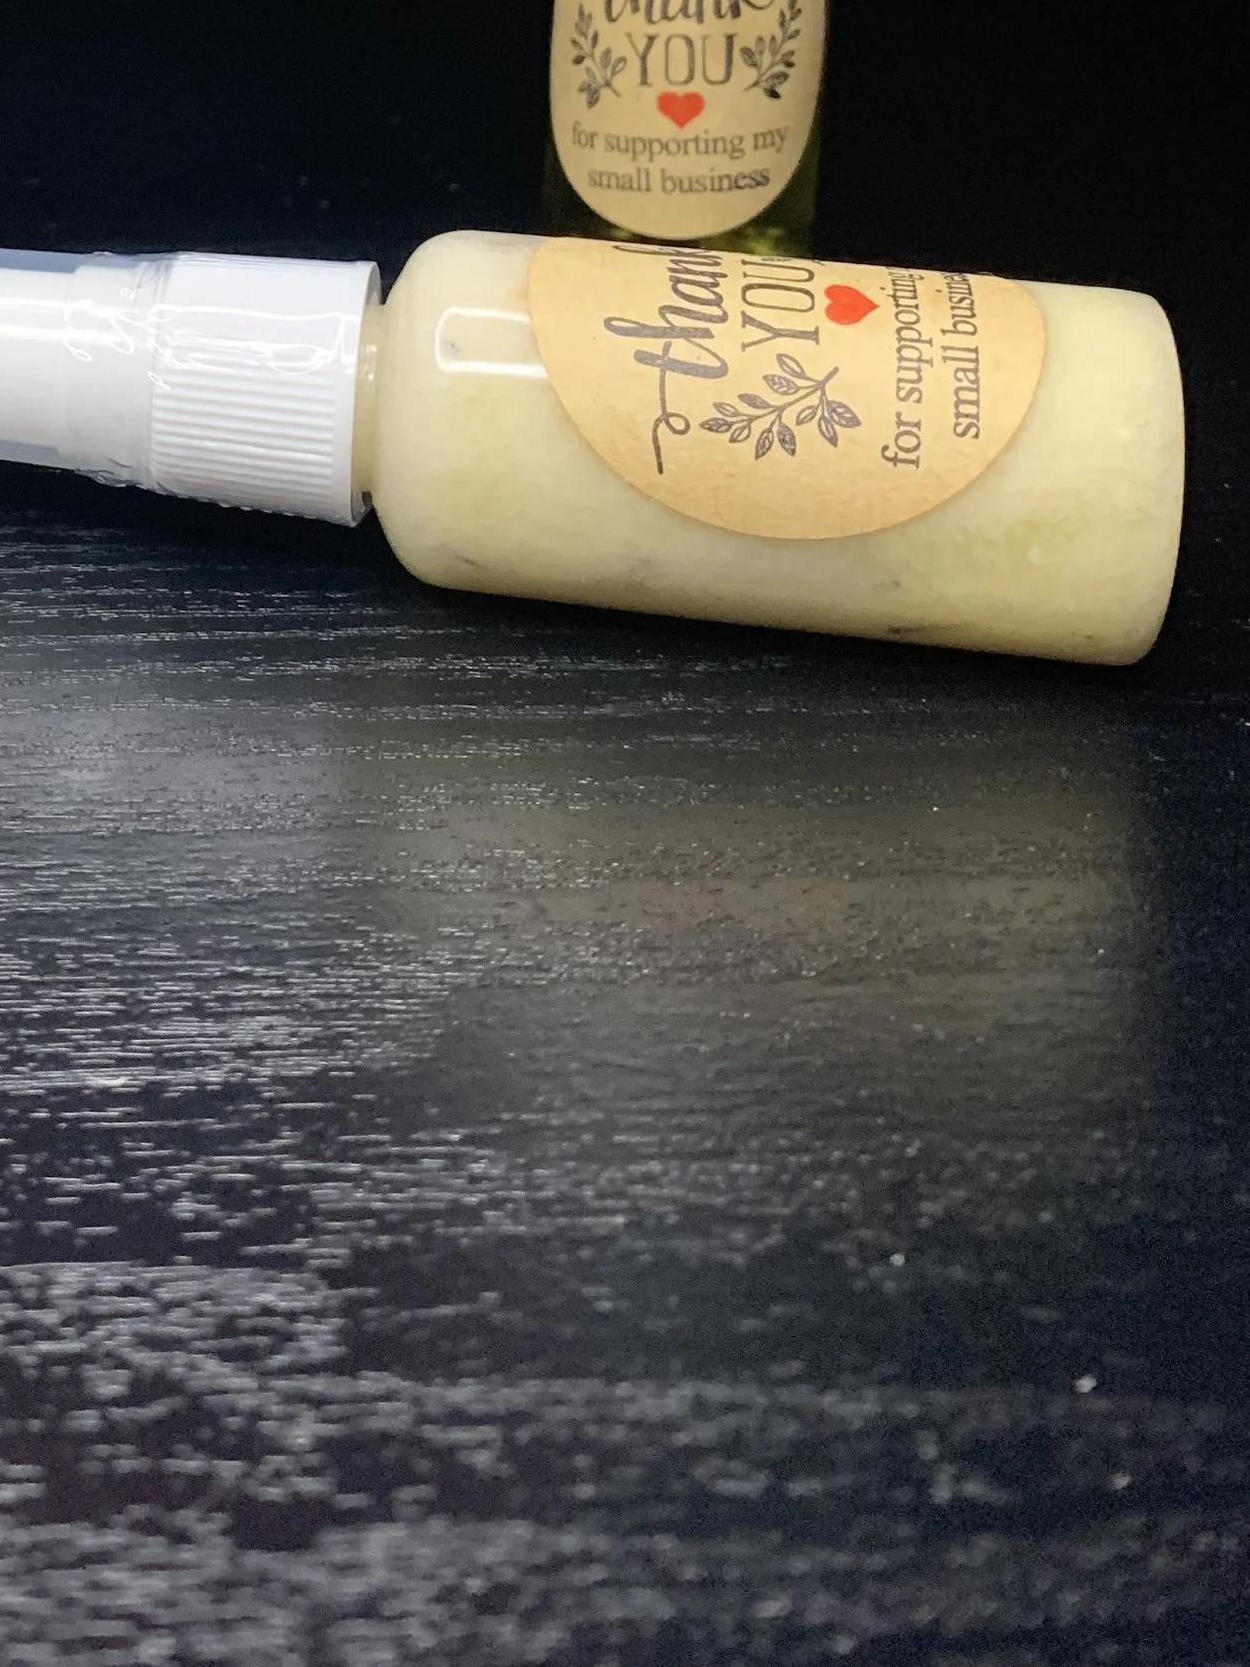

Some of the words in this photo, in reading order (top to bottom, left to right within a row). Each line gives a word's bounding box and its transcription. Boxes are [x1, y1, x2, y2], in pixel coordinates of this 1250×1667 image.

[625, 32, 737, 86] YOU
[571, 120, 597, 149] for
[603, 128, 745, 161] supporting
[752, 125, 789, 152] my
[587, 167, 651, 193] small
[660, 166, 770, 194] business
[741, 258, 820, 352] YOU
[934, 271, 979, 337] busine
[940, 345, 980, 440] small
[881, 411, 922, 470] for
